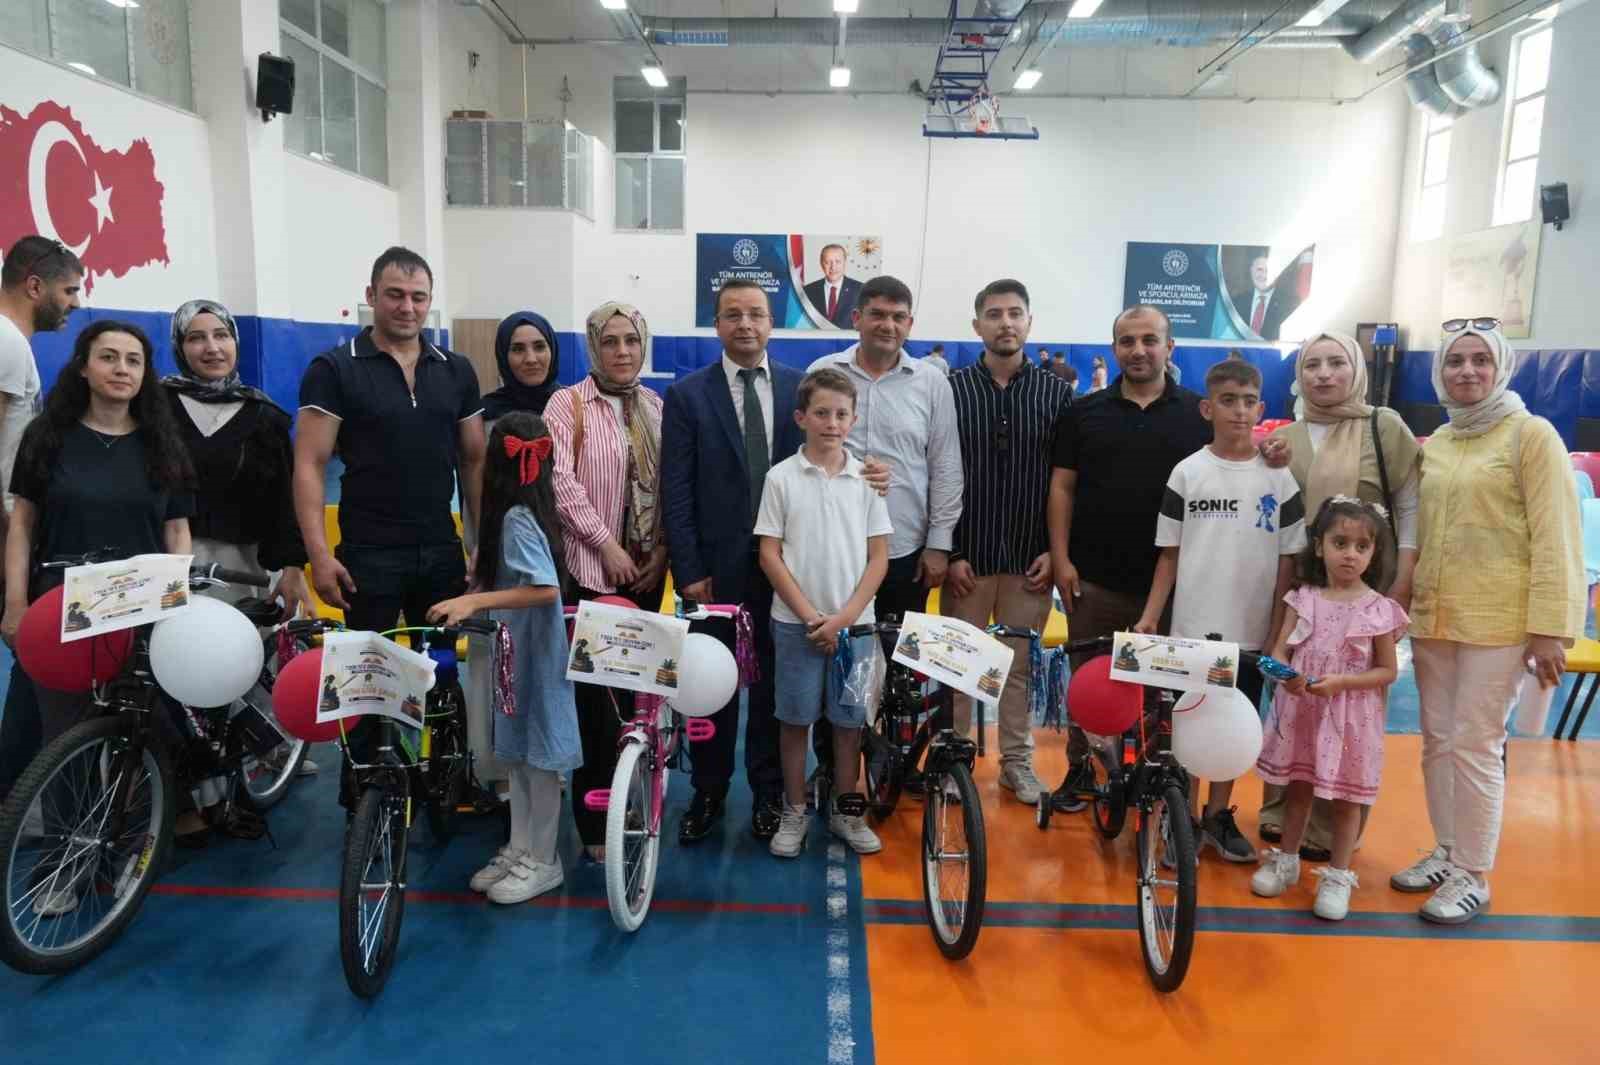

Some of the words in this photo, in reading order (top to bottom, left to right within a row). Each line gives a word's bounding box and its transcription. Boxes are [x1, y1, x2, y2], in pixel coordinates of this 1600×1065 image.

[1147, 282, 1162, 290] TÜM
[1163, 283, 1200, 291] ANTRENÖR
[1188, 499, 1238, 512] SONIC
